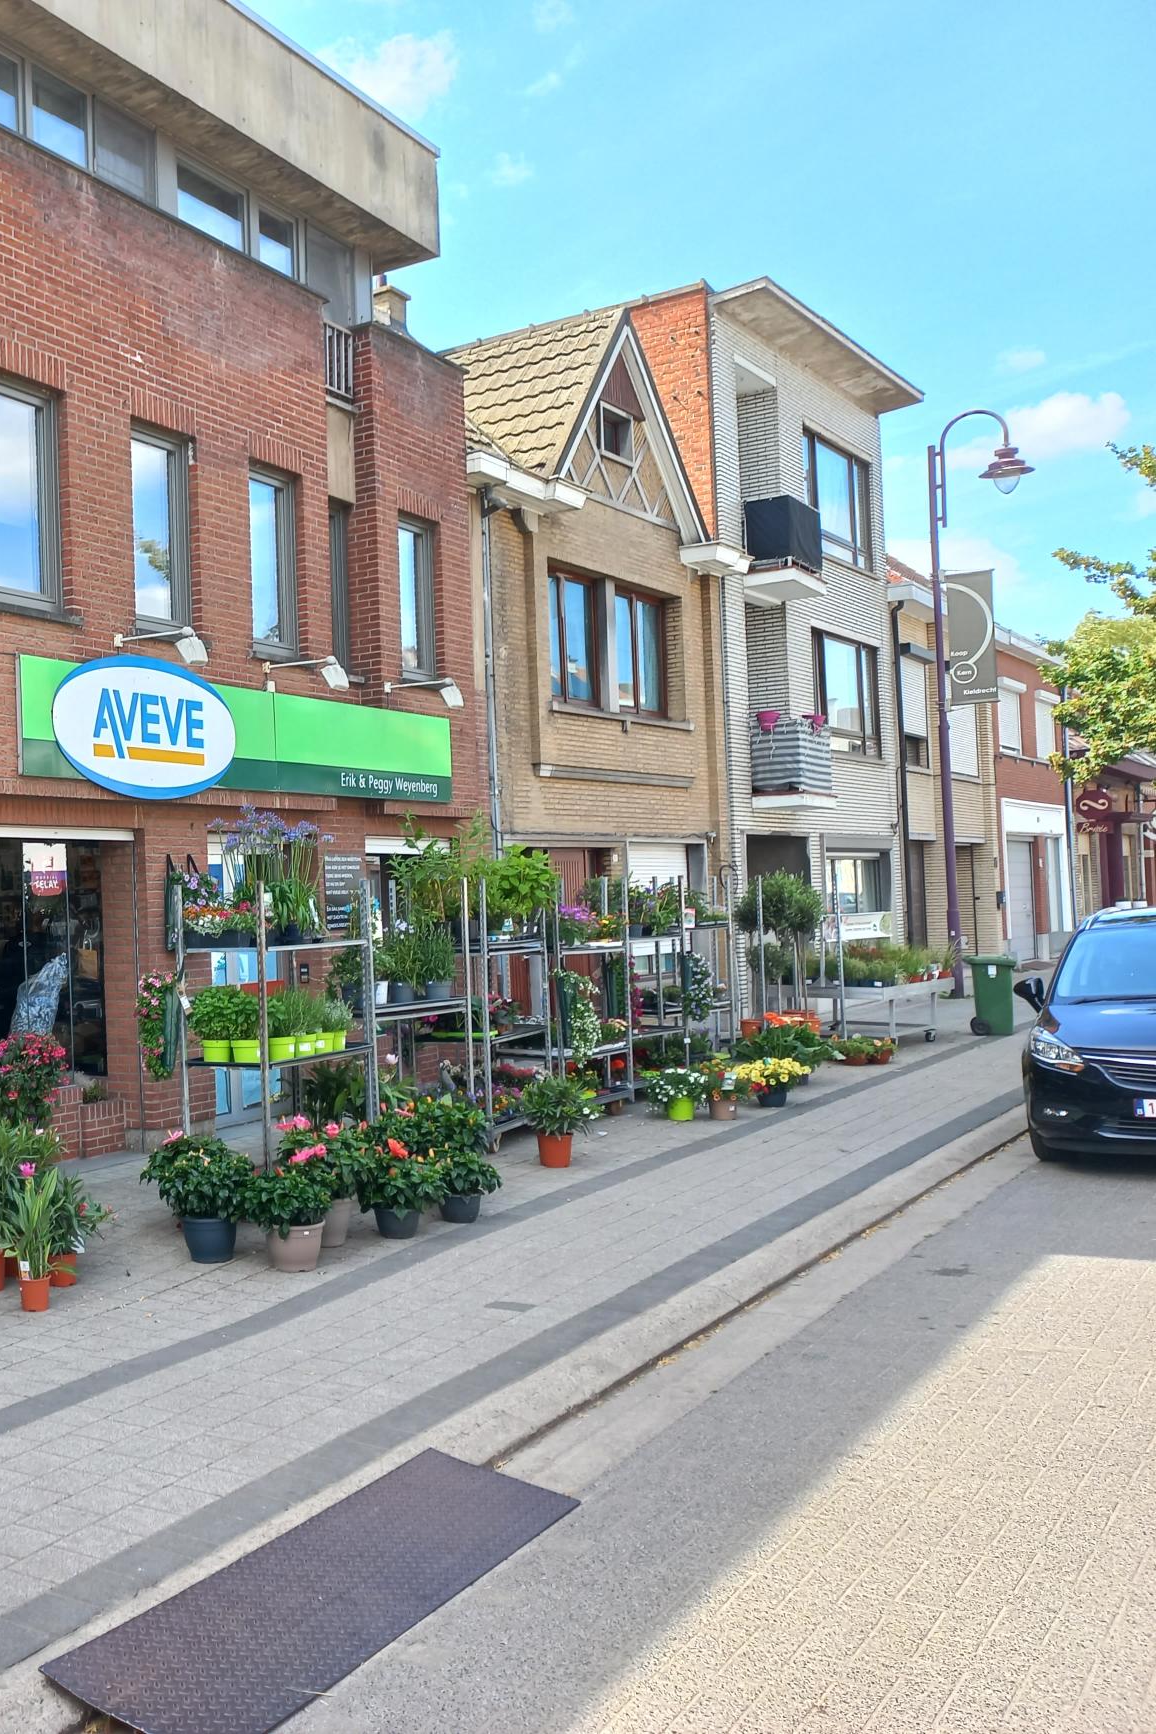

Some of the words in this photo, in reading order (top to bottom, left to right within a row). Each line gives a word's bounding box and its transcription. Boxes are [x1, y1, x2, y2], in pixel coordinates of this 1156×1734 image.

[963, 687, 997, 695] Kieldrecht
[93, 688, 205, 759] AVEVE
[341, 772, 357, 788] Erik
[359, 774, 366, 789] &
[368, 775, 394, 794] Peggy
[395, 777, 438, 797] Weyenberg
